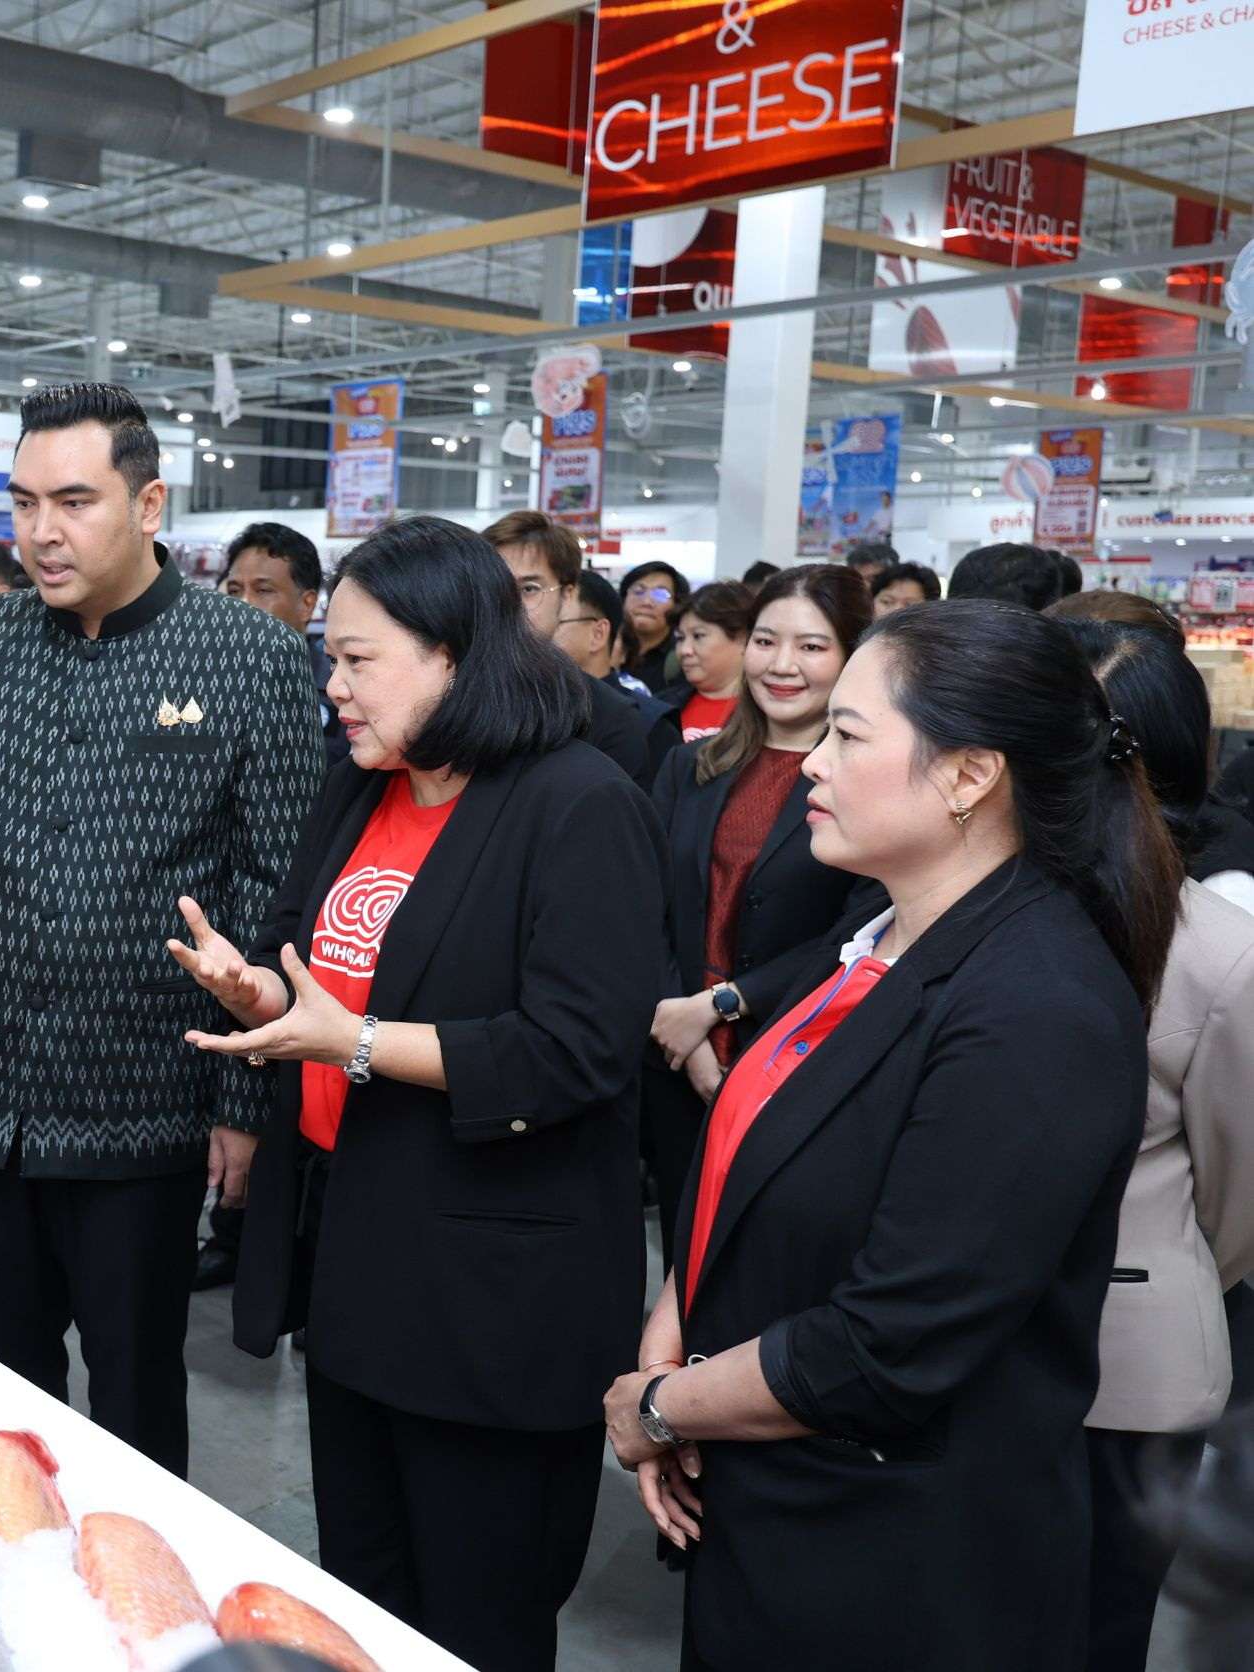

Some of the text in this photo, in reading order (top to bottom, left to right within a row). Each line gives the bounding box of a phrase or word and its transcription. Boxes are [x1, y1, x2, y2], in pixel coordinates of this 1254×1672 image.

[715, 0, 756, 54] &
[1123, 15, 1195, 45] CHEESE
[1200, 11, 1214, 30] &
[596, 38, 889, 173] CHEESE
[953, 154, 1018, 196] FRUIT
[953, 193, 1076, 258] VEGETABLE
[1116, 514, 1192, 527] CUSTER
